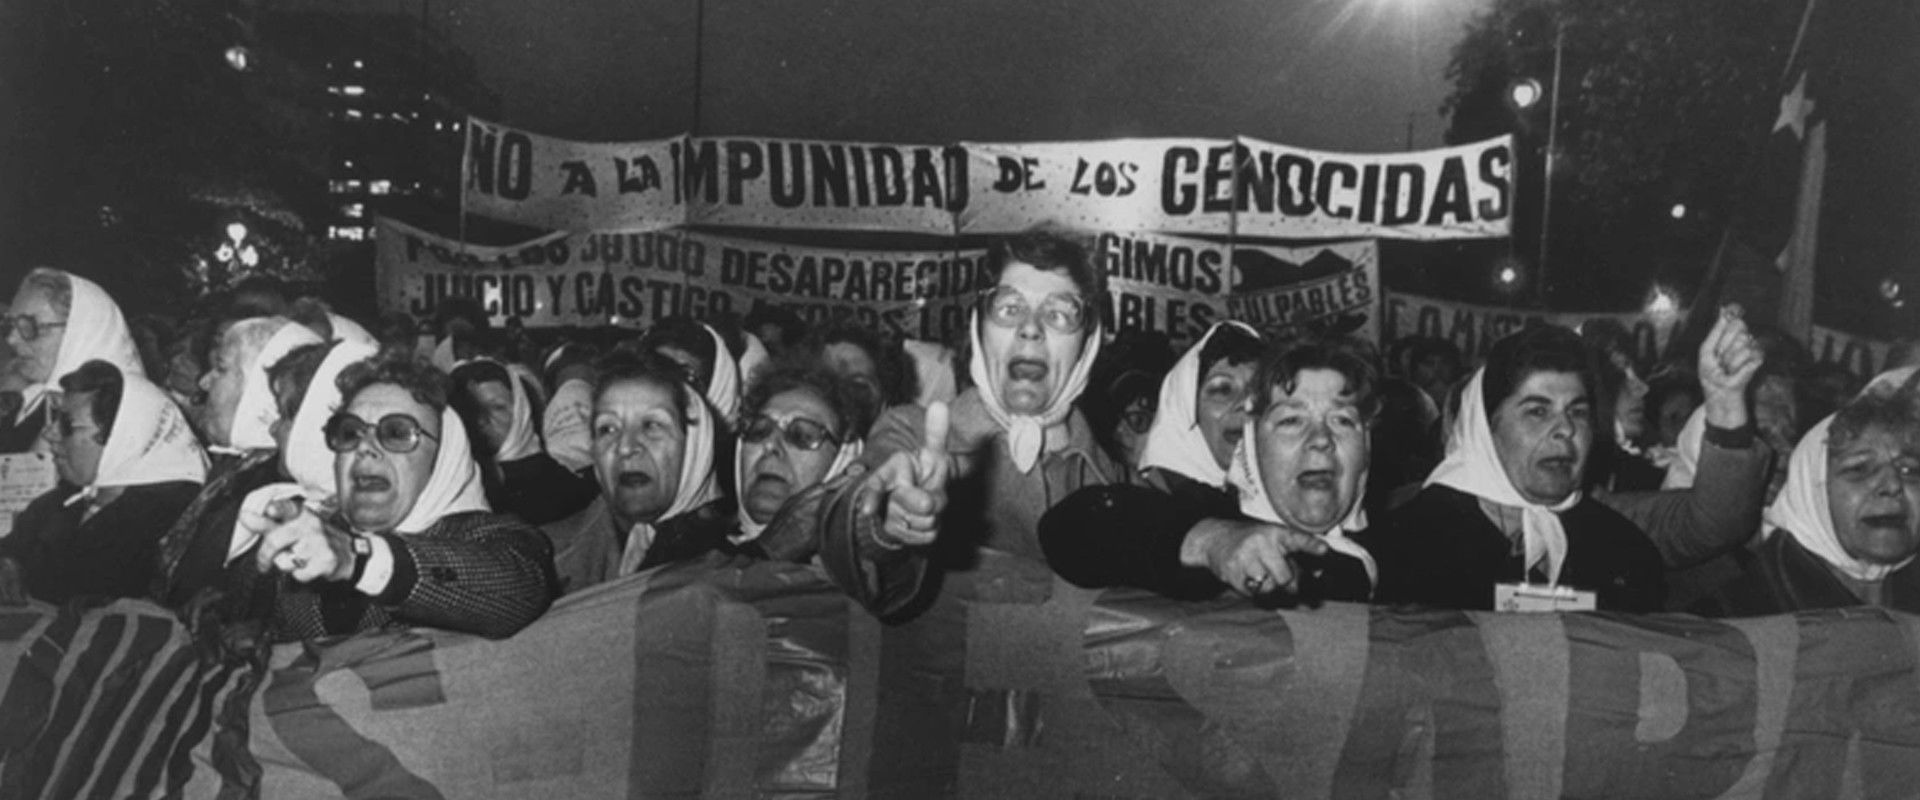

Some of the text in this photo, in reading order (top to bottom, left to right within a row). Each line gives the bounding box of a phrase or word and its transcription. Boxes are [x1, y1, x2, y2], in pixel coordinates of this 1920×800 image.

[467, 125, 1511, 226] NO A LA IMPUNIDAD DE LOS GENOCIDAS
[1098, 232, 1222, 295] GIMOS
[547, 273, 566, 315] Y
[1094, 287, 1220, 342] ABLES
